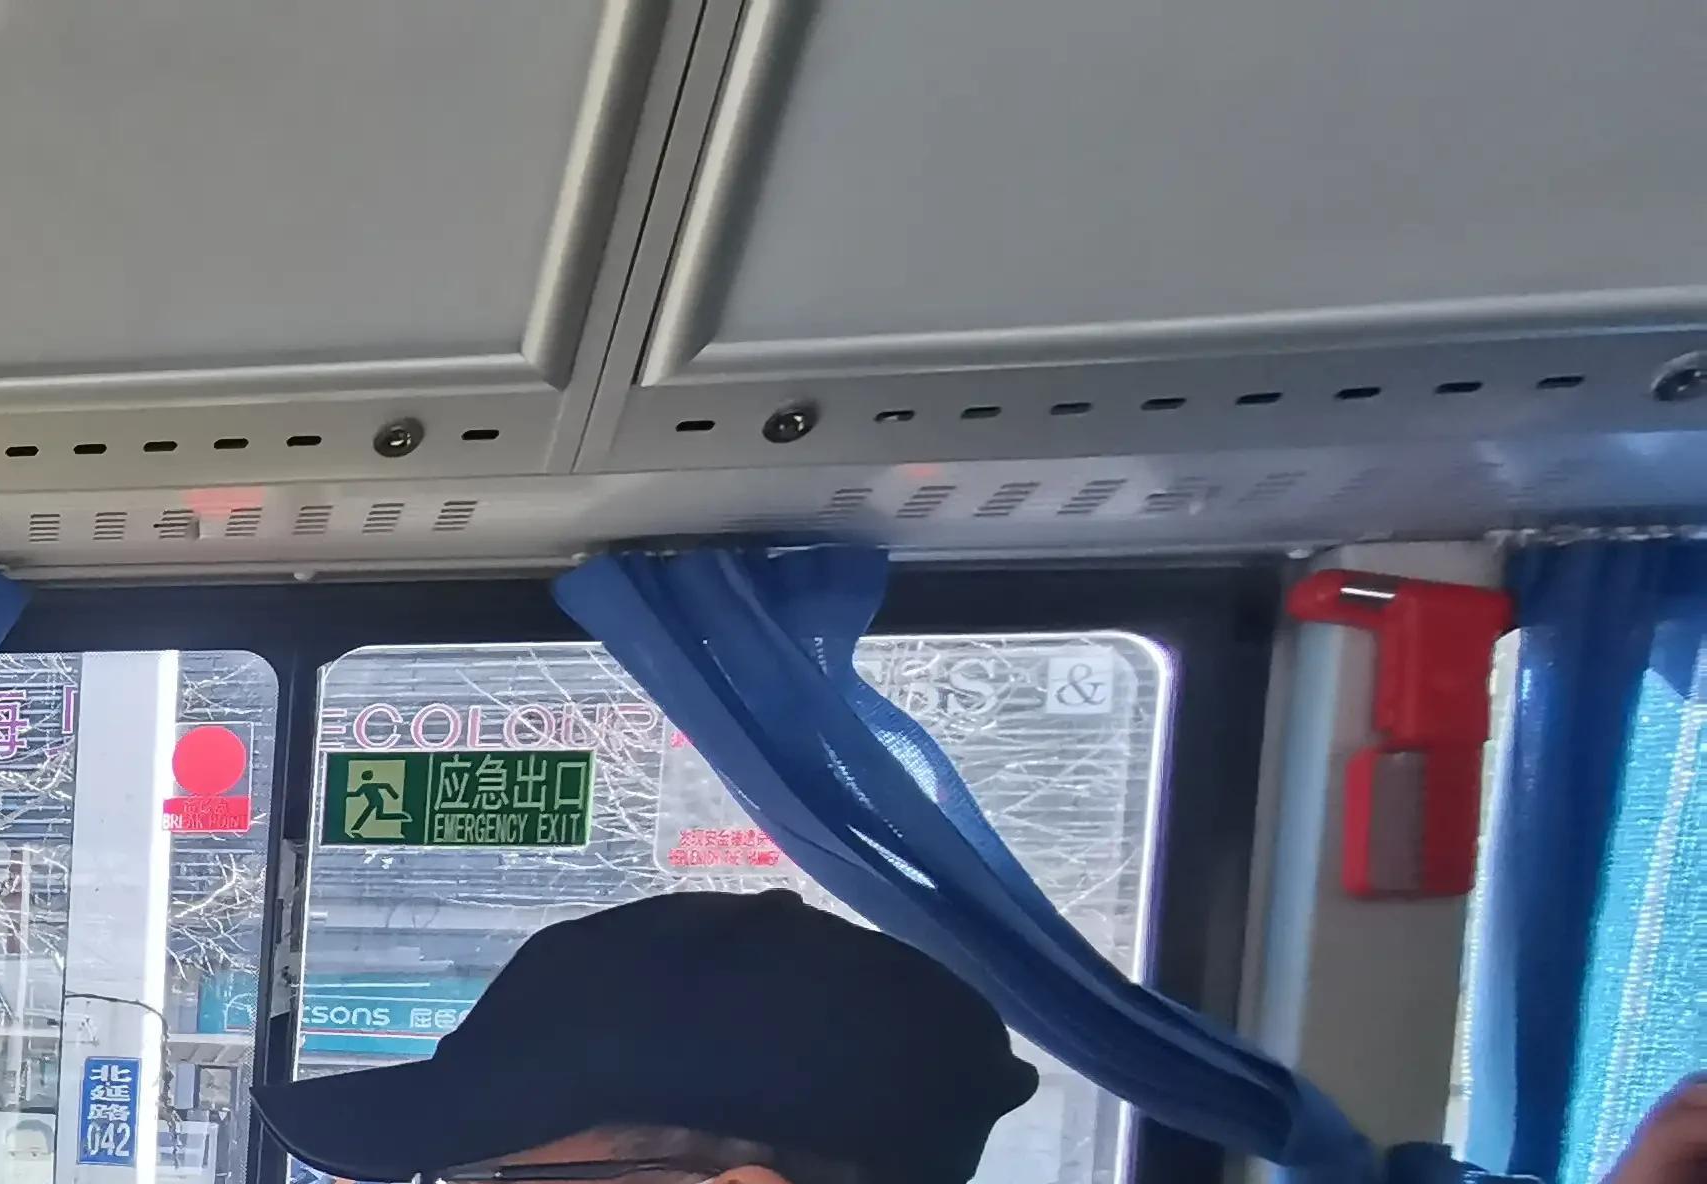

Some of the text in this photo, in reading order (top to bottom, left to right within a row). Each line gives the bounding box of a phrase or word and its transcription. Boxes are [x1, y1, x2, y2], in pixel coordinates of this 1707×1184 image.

[1055, 663, 1106, 705] &
[434, 754, 589, 811] 应急出口
[434, 814, 582, 843] EMERGENCY EXIT
[87, 1122, 131, 1157] 042
